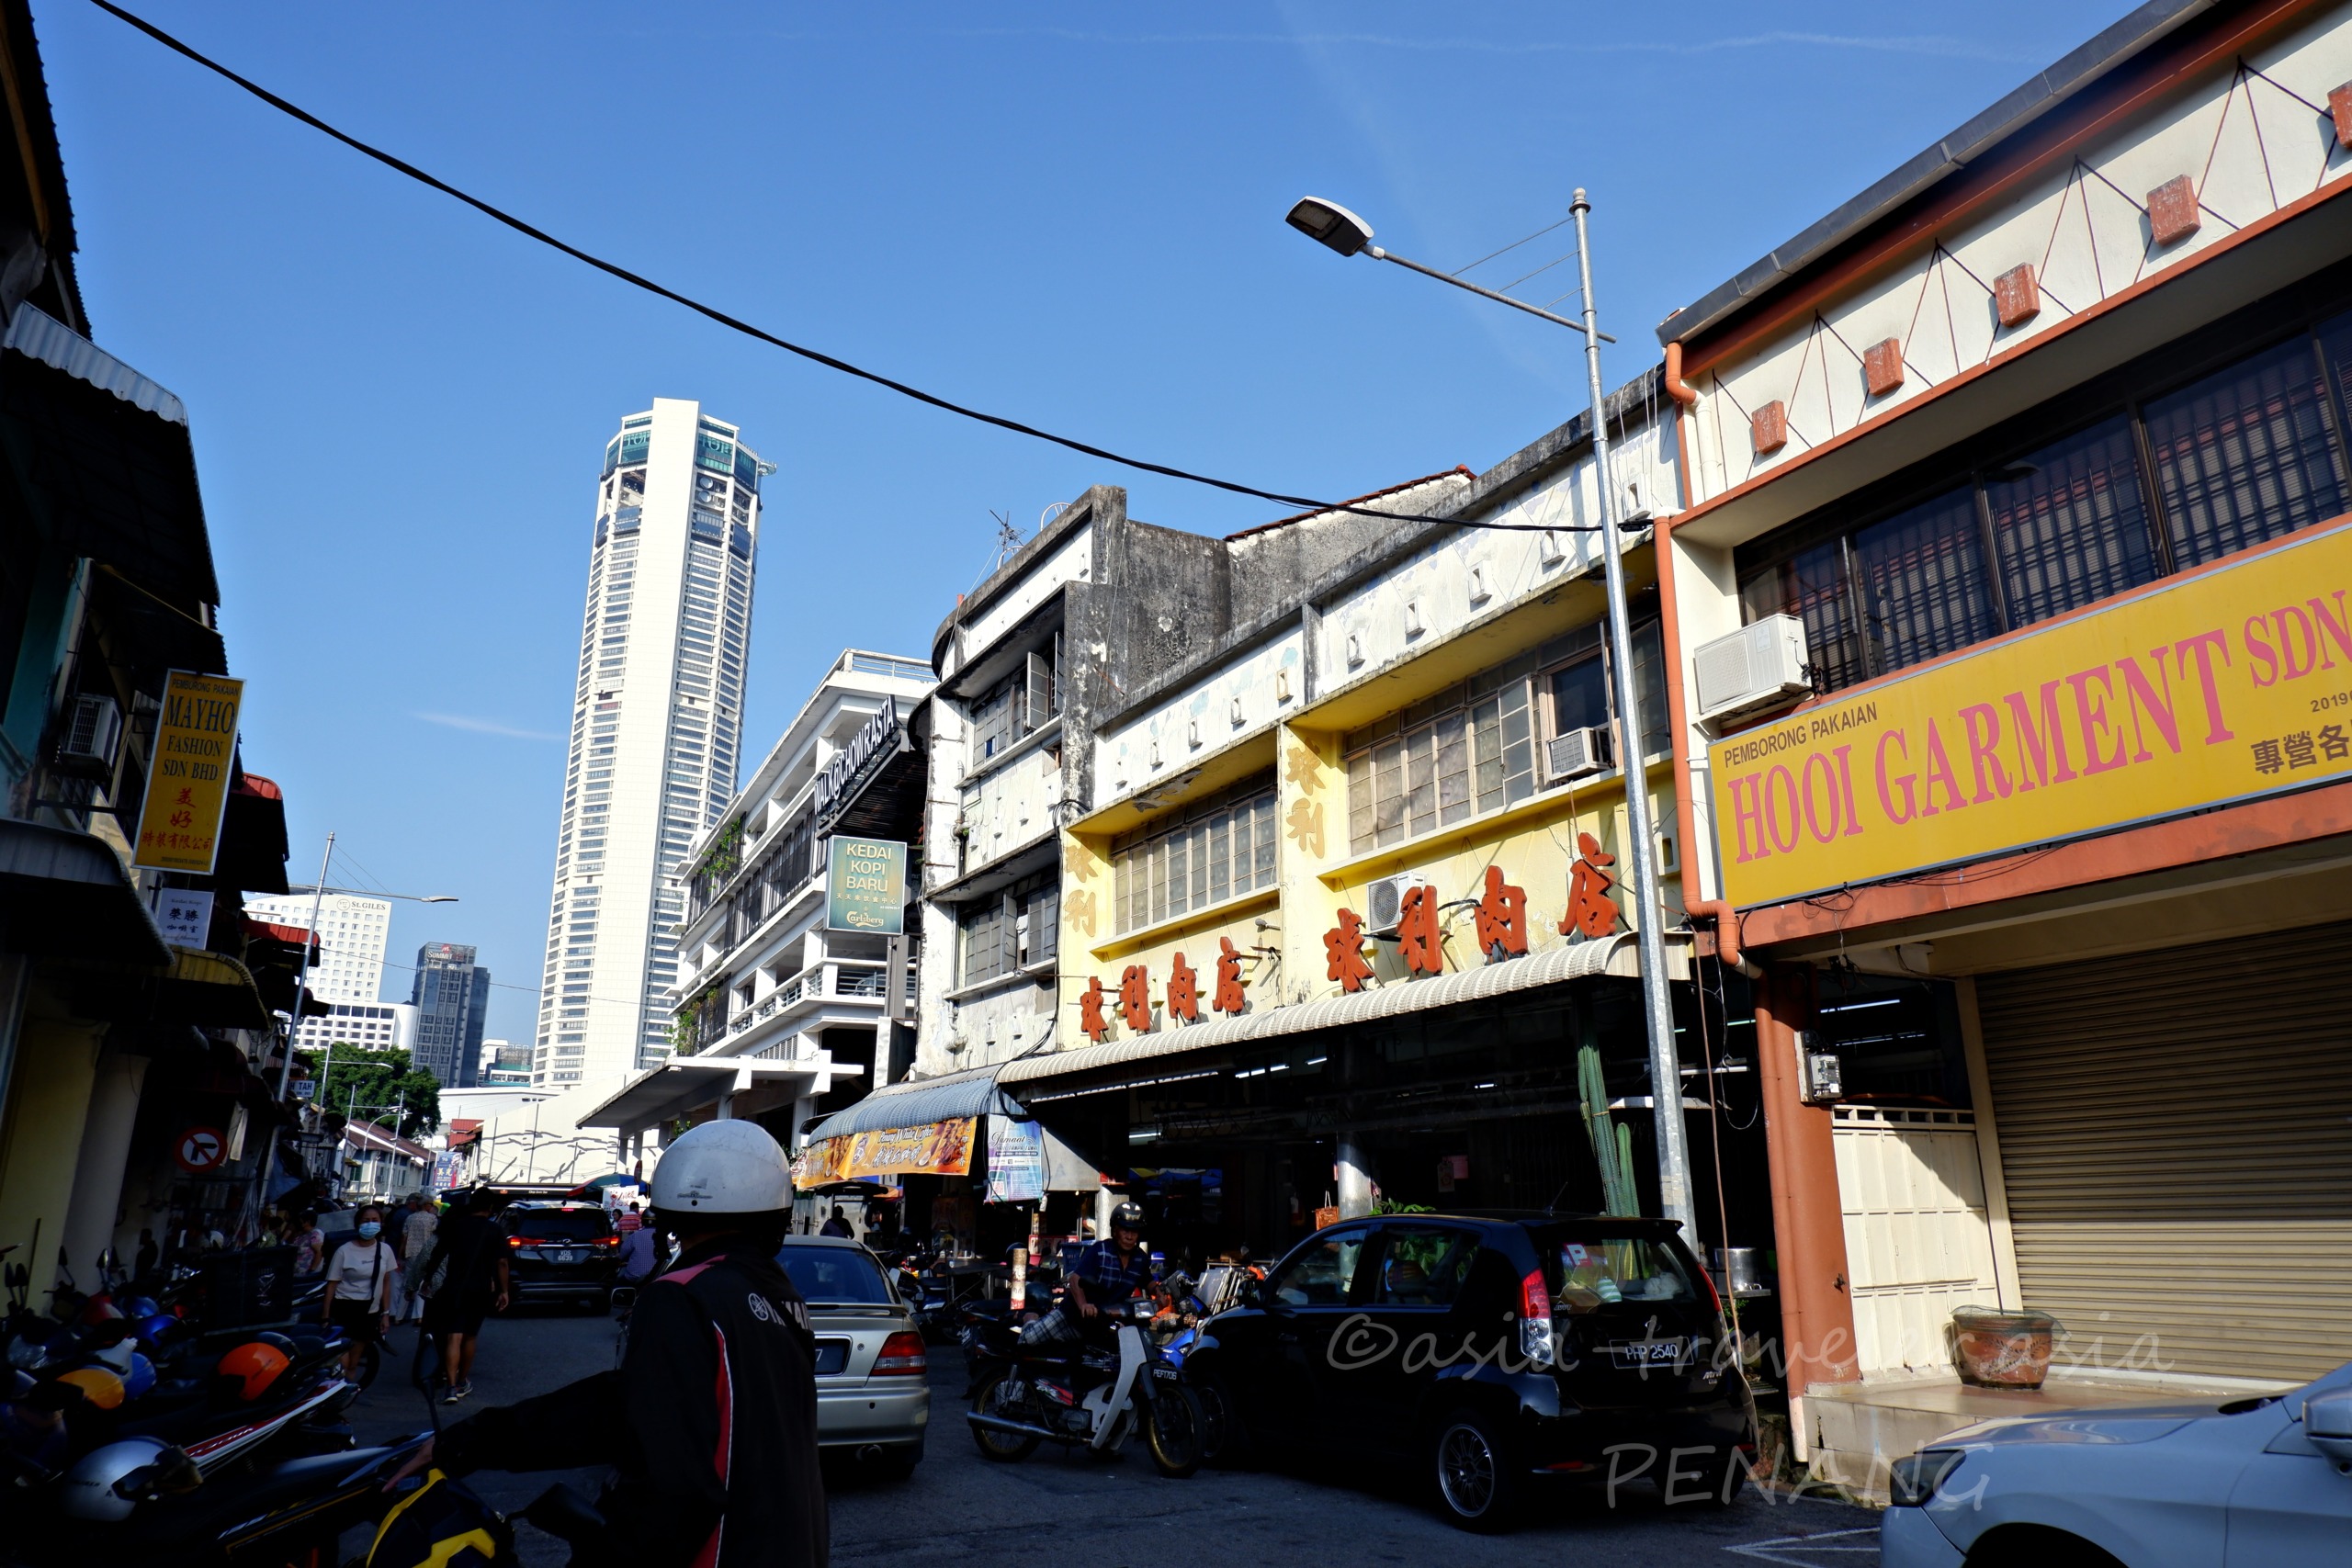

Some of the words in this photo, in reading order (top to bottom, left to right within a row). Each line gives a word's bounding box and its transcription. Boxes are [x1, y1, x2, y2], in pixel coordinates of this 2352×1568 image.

[173, 678, 210, 694] PEMBORONG
[212, 682, 239, 695] PAKAIAN
[2310, 690, 2352, 713] 2019
[164, 694, 235, 734] MAYHO
[1724, 724, 1807, 768] PEMBORONG
[1811, 701, 1878, 739] PAKAIAN
[1728, 744, 1863, 864] HOOI
[1874, 628, 2235, 826] GARMENT
[2244, 589, 2352, 689] SDN
[166, 735, 223, 757] FASHION
[814, 694, 895, 815] WALK@CHOWRASTA
[2250, 719, 2352, 775] 專營各
[162, 759, 186, 777] SDN
[191, 762, 219, 781] BHD
[846, 843, 892, 861] KEDAI
[850, 861, 886, 875] KOPI
[846, 875, 888, 893] BARU
[846, 911, 884, 927] Carlsberg
[912, 1125, 934, 1142] Coffee
[992, 1131, 1027, 1148] Jumaat
[1625, 1346, 1647, 1360] PHP
[1651, 1343, 1679, 1359] 2540
